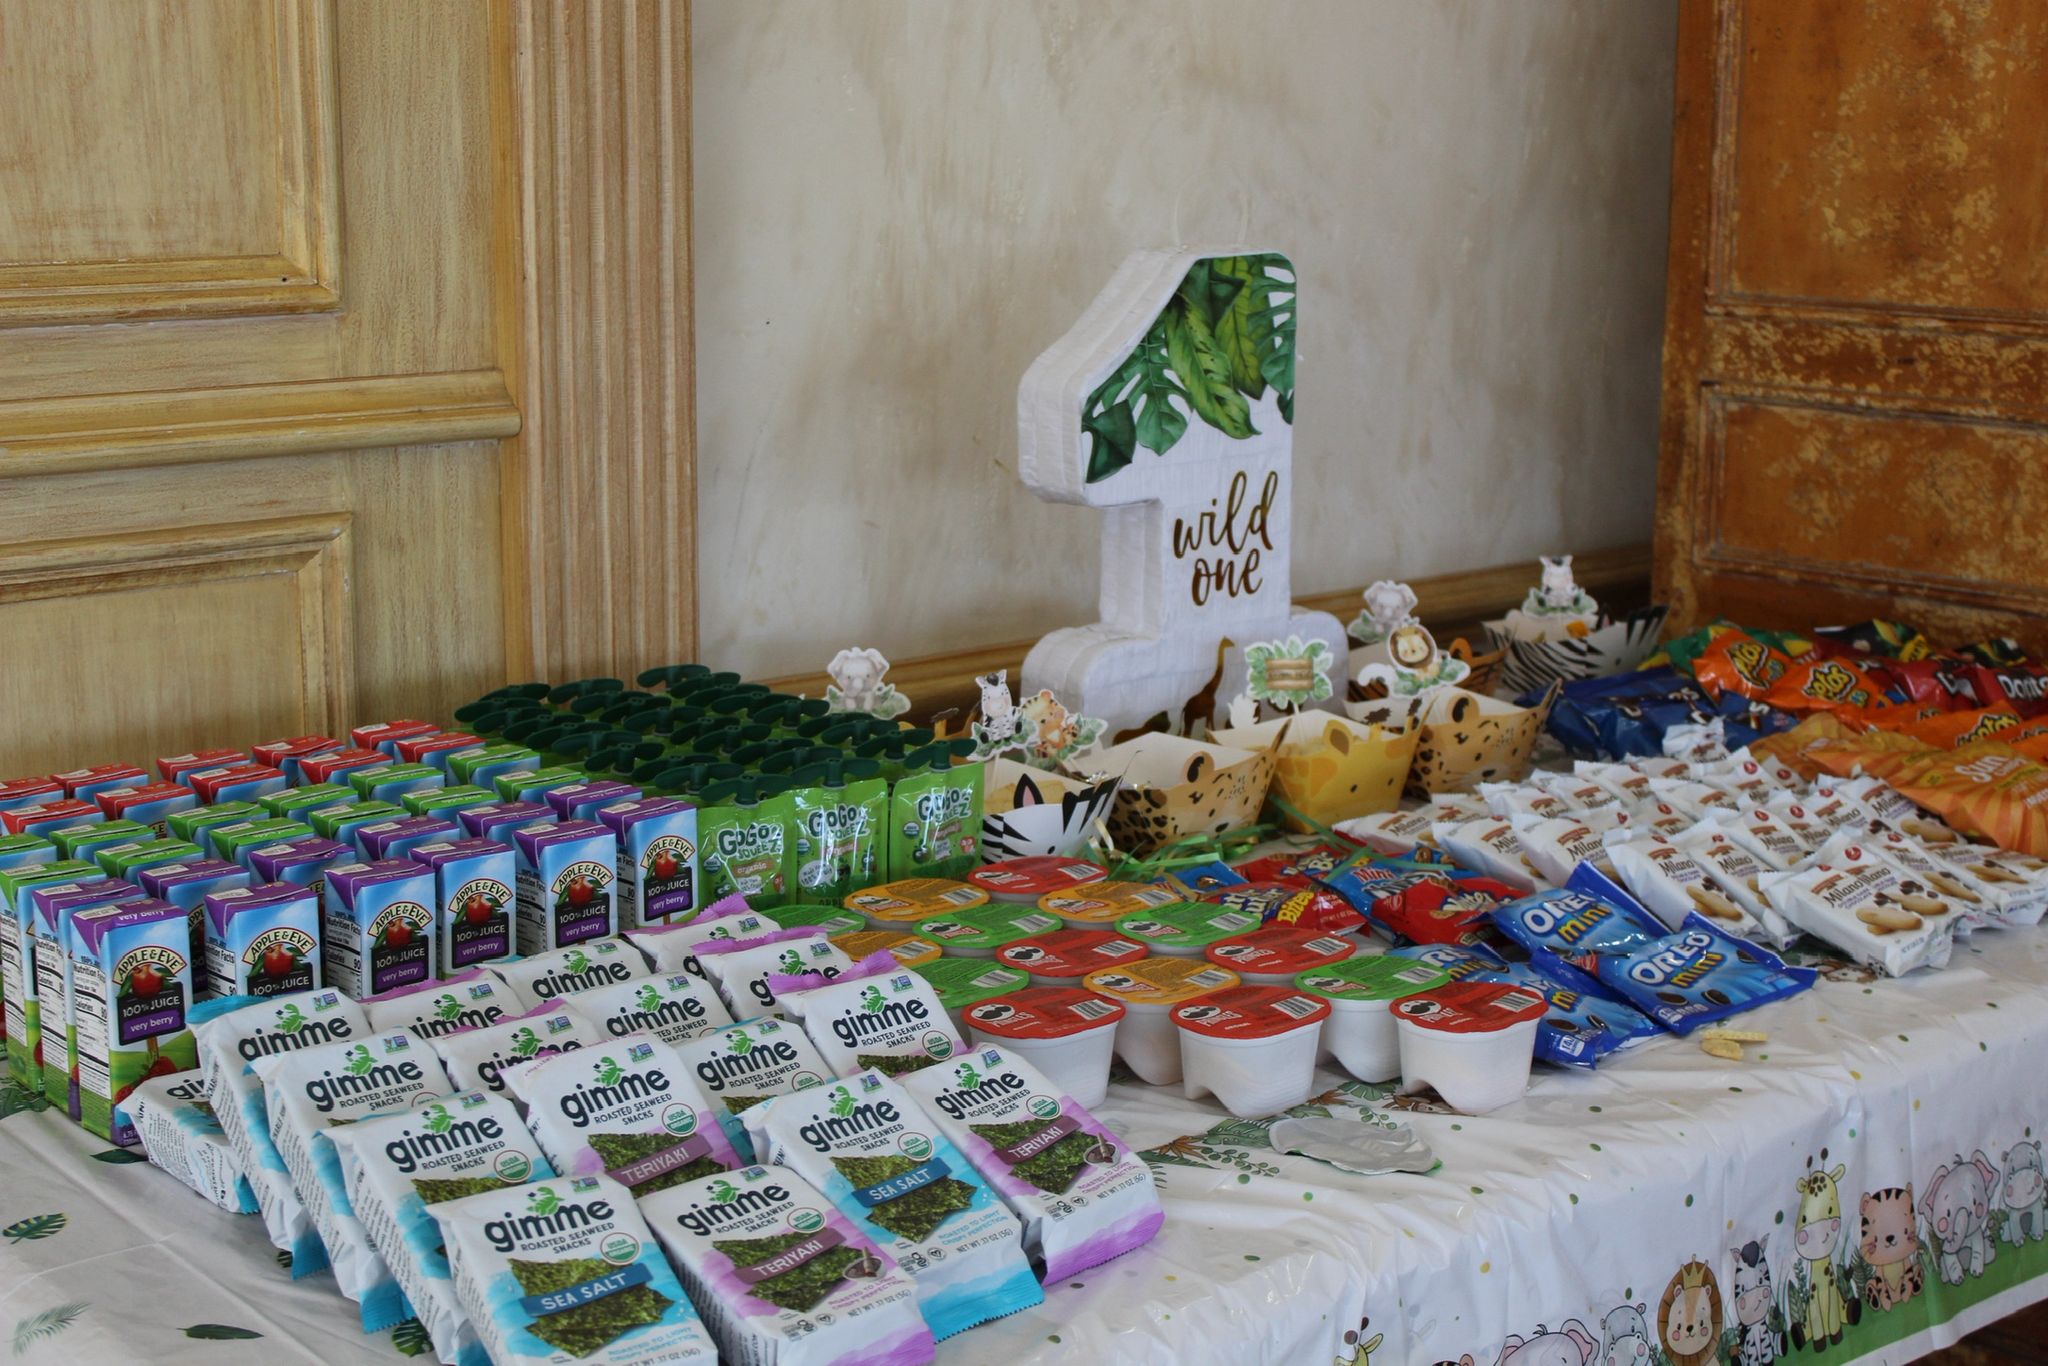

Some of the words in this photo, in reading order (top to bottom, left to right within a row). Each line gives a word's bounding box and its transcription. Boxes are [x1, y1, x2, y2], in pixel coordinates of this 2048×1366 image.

[1173, 470, 1278, 559] wild
[1192, 548, 1263, 606] one
[1954, 755, 2010, 783] Sun
[645, 838, 669, 867] APPLE
[674, 839, 692, 857] EVE
[1492, 835, 1519, 854] Mila
[556, 865, 585, 891] APPLE
[591, 865, 611, 882] EVE
[1658, 859, 1695, 878] Milano
[1717, 855, 1753, 874] Milano
[452, 882, 482, 909] APPLE
[488, 883, 509, 900] EVE
[667, 878, 690, 892] JUICE
[1822, 880, 1865, 908] Milano
[581, 905, 606, 920] JUICE
[653, 900, 666, 912] very
[666, 894, 684, 907] berry
[1277, 890, 1316, 926] Bites
[374, 904, 402, 935] APPLE
[409, 904, 429, 926] EVE
[479, 923, 506, 937] JUICE
[565, 927, 580, 938] very
[581, 922, 600, 934] berry
[1557, 903, 1612, 943] mini
[250, 930, 281, 960] APPLE
[289, 931, 310, 952] EVE
[399, 947, 425, 963] JUICE
[462, 943, 479, 956] very
[479, 940, 499, 954] berry
[1630, 933, 1712, 985] OREO
[116, 948, 149, 981] APPLE
[157, 949, 182, 972] EVE
[381, 970, 397, 983] very
[397, 965, 418, 980] berry
[1670, 952, 1723, 988] mini
[253, 982, 280, 997] 100%
[281, 975, 310, 990] JUICE
[122, 1001, 150, 1019] 100%
[150, 994, 181, 1011] JUICE
[1551, 991, 1579, 1010] mi
[130, 1021, 148, 1033] very
[150, 1014, 174, 1029] berry
[671, 1019, 708, 1036] SEAWEED
[832, 998, 930, 1048] gimme
[861, 1029, 898, 1048] ROASTED
[896, 1021, 931, 1039] SEAWEED
[885, 1033, 916, 1049] SNACKS
[697, 1039, 798, 1092] gimme
[728, 1071, 766, 1089] ROASTED
[765, 1061, 801, 1079] SEAWEED
[305, 1060, 424, 1113] gimme
[339, 1091, 381, 1109] ROASTED
[382, 1081, 425, 1099] SEAWEED
[754, 1075, 785, 1091] SNACKS
[934, 1070, 1025, 1121] gimme
[369, 1096, 404, 1112] SNACKS
[561, 1068, 670, 1128] gimme
[594, 1107, 633, 1125] ROASTED
[633, 1092, 673, 1112] SEAWEED
[967, 1100, 999, 1119] ROASTED
[997, 1087, 1031, 1105] SEAWEED
[991, 1101, 1020, 1119] SNACKS
[622, 1110, 655, 1126] SNACKS
[800, 1098, 901, 1153] gimme
[386, 1116, 504, 1173] gimme
[834, 1134, 869, 1151] ROASTED
[868, 1122, 905, 1141] SEAWEED
[860, 1137, 891, 1152] SNACKS
[1007, 1125, 1064, 1160] TERIYAKI
[421, 1153, 463, 1171] ROASTED
[463, 1140, 506, 1158] SEAWEED
[452, 1156, 486, 1173] SNACKS
[620, 1147, 690, 1183] TERIYAKI
[869, 1183, 897, 1202] SEA
[898, 1168, 931, 1193] SALT
[677, 1183, 790, 1236] gimme
[715, 1216, 754, 1234] ROASTED
[755, 1201, 795, 1220] SEAWEED
[484, 1198, 616, 1253] gimme
[520, 1235, 567, 1252] ROASTED
[568, 1222, 615, 1240] SEAWEED
[745, 1216, 779, 1233] SNACKS
[552, 1238, 591, 1254] SNACKS
[752, 1239, 824, 1277] TERIYAKI
[541, 1291, 577, 1311] SEA
[579, 1272, 628, 1300] SALT
